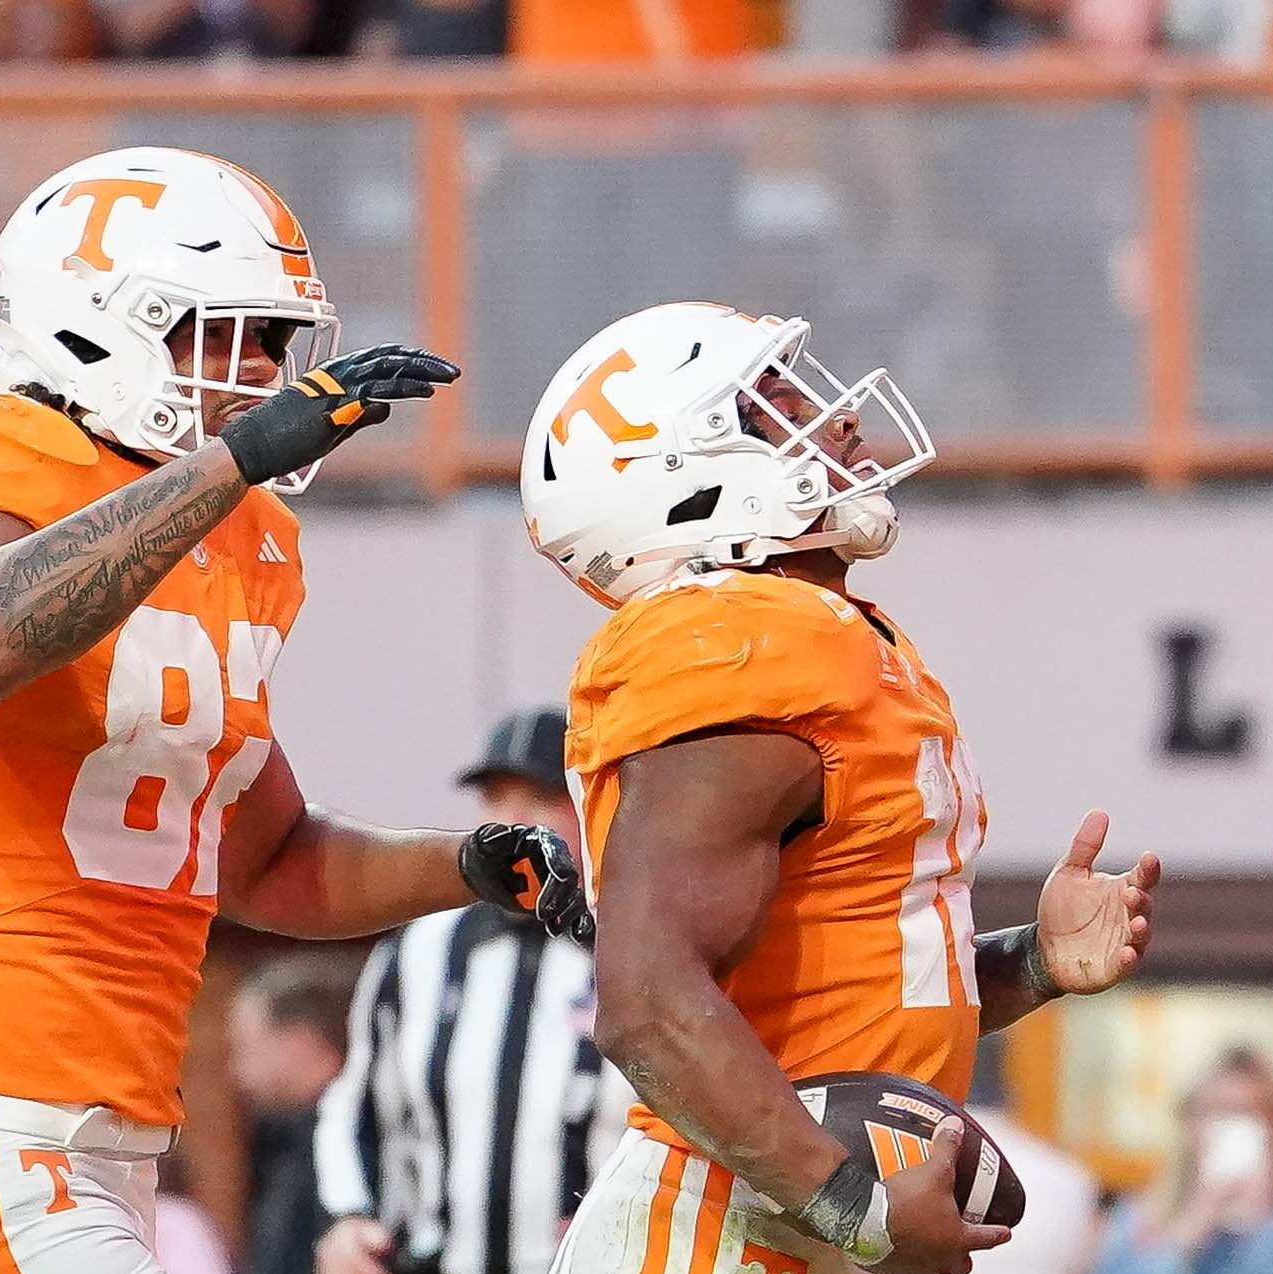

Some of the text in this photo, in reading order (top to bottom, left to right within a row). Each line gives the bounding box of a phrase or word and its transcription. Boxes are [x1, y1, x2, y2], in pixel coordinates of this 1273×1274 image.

[60, 178, 167, 272] T
[551, 348, 658, 473] T
[883, 1093, 942, 1121] DIME
[19, 1149, 77, 1214] T
